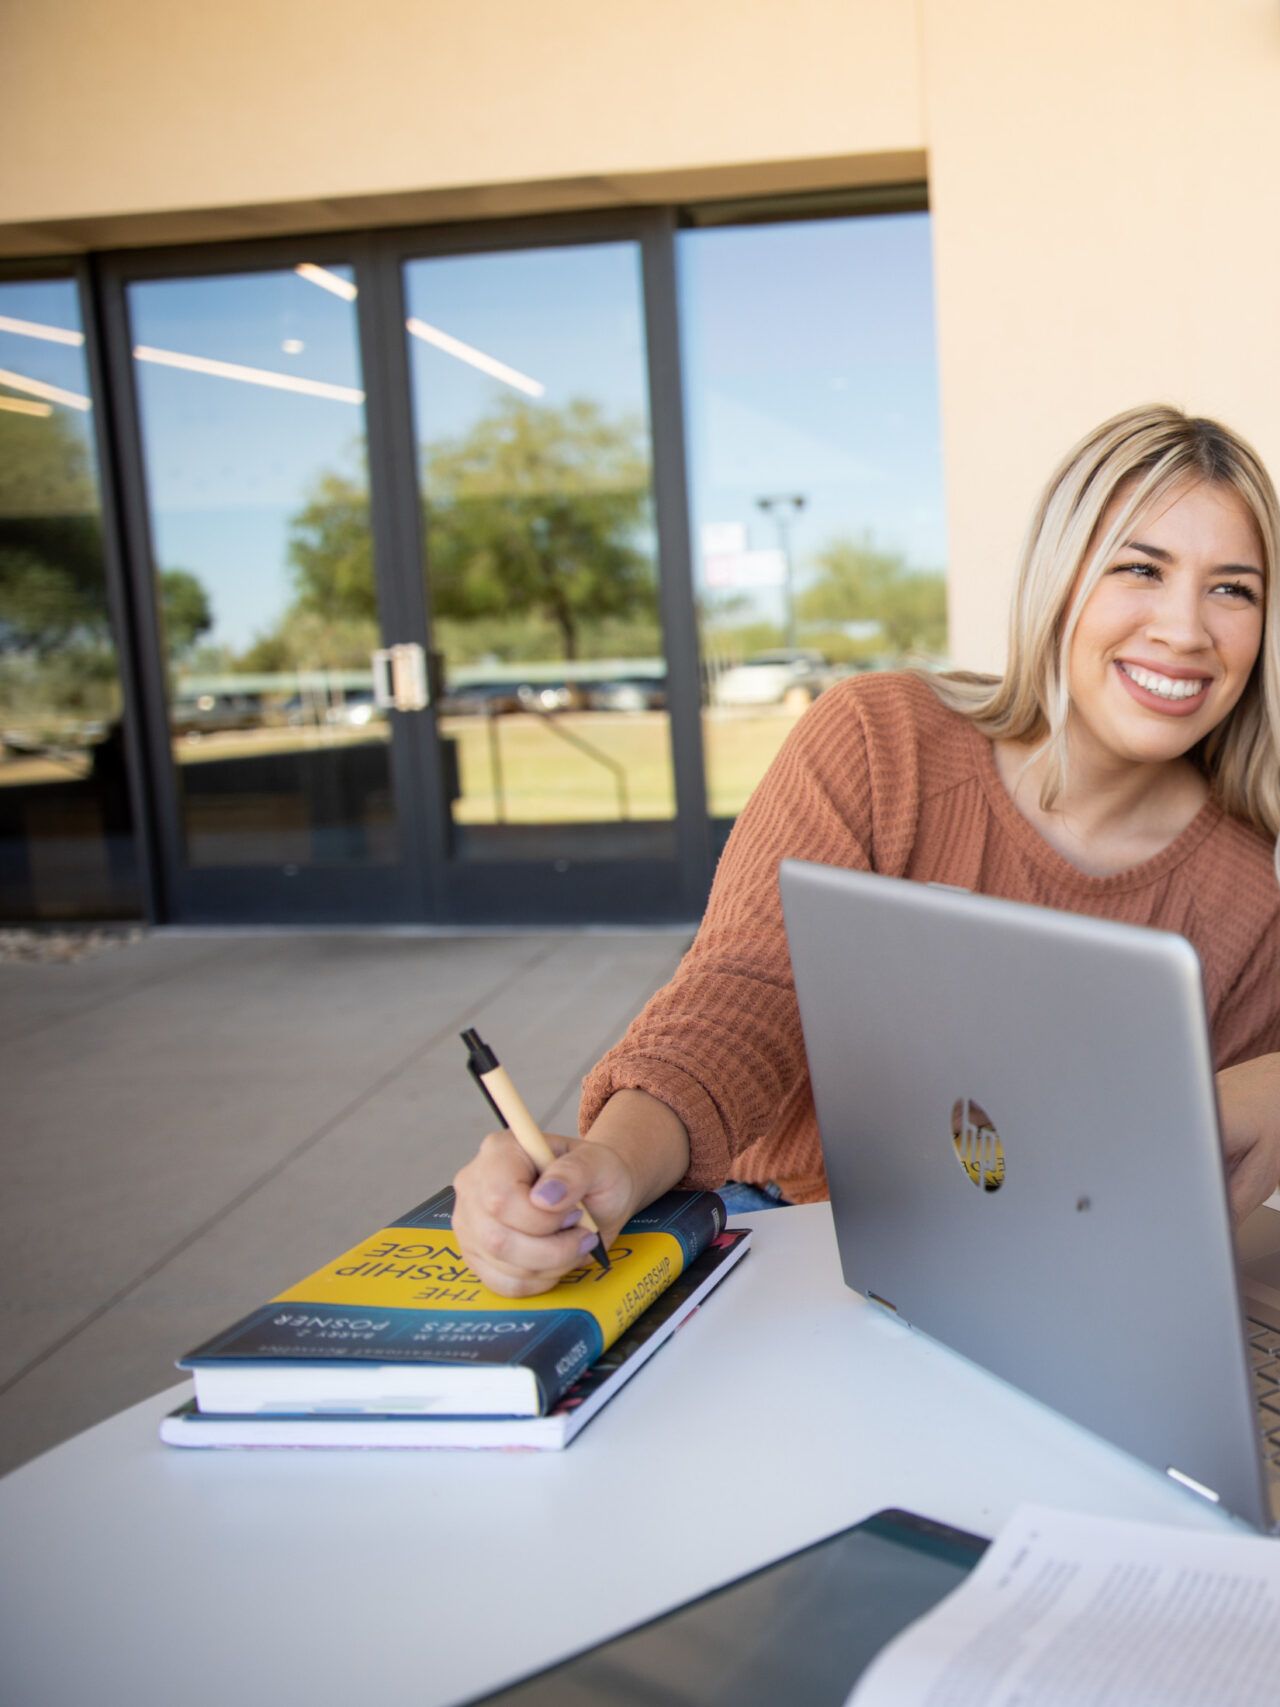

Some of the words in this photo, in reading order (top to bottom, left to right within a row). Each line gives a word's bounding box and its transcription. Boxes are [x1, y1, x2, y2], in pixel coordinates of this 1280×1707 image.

[622, 1256, 670, 1313] LEADERSHIP
[411, 1286, 481, 1301] THE
[273, 1314, 391, 1331] POSNER
[420, 1321, 536, 1333] KOUZES
[316, 1330, 375, 1340] BARRY
[439, 1333, 499, 1342] JAMES
